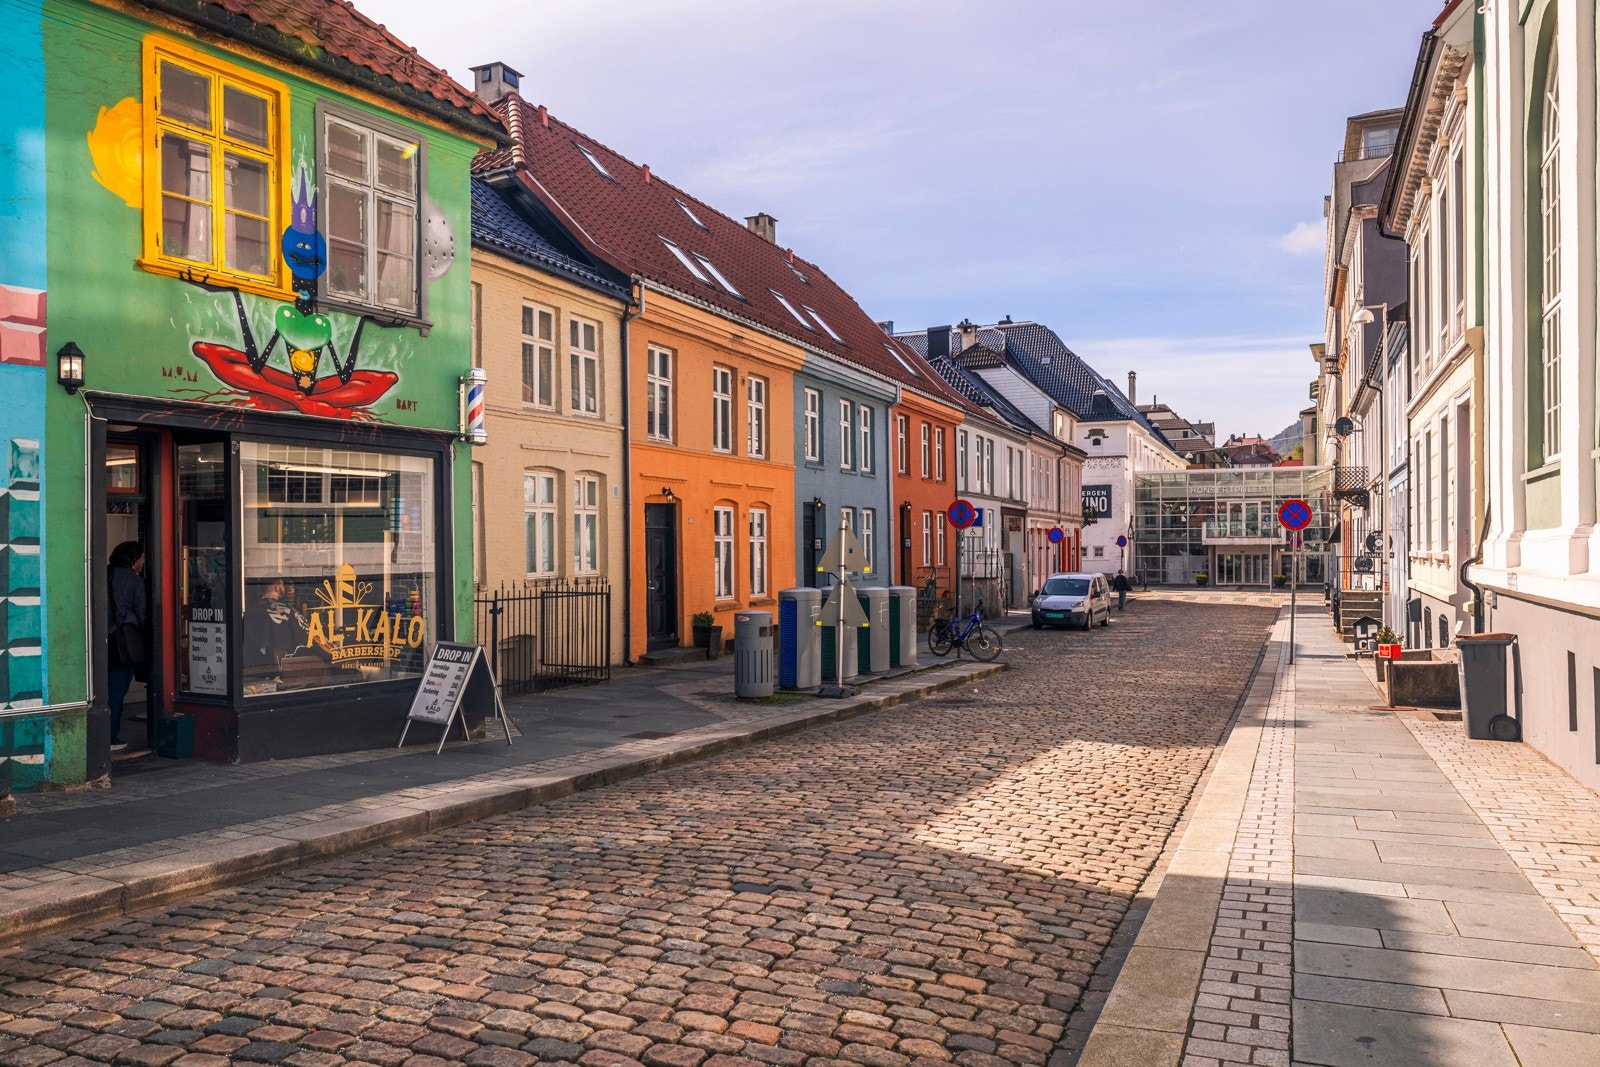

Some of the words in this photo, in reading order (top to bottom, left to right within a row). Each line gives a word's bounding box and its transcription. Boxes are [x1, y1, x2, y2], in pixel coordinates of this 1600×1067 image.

[396, 399, 418, 412] BART
[1082, 496, 1108, 513] INO
[192, 608, 213, 621] DROP
[215, 609, 223, 621] IN
[306, 608, 425, 649] AL-KALO
[1356, 624, 1378, 639] LP
[331, 646, 400, 660] BARBERSHOP
[437, 648, 462, 661] DROP
[461, 651, 473, 663] IN
